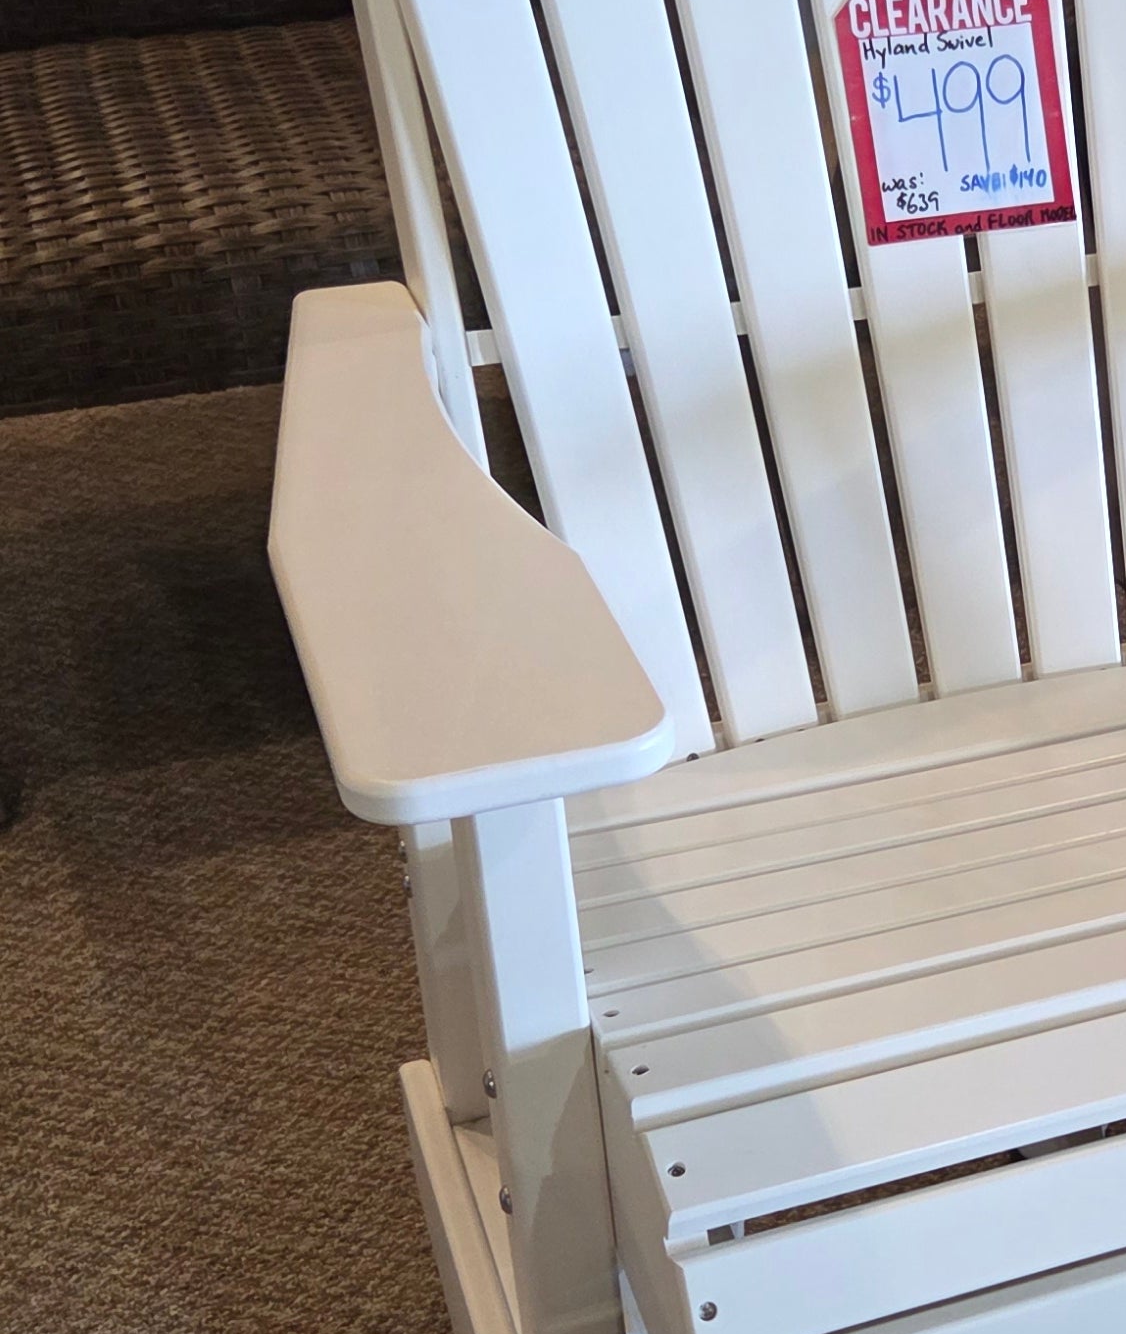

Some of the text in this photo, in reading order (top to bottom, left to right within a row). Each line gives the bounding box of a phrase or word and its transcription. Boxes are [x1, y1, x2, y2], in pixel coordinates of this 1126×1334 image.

[862, 25, 993, 69] Hyland Swivel
[897, 191, 940, 214] $639
[871, 225, 889, 242] IN
[897, 220, 949, 240] STOCK
[954, 215, 983, 234] and
[988, 208, 1035, 229] FLOOR
